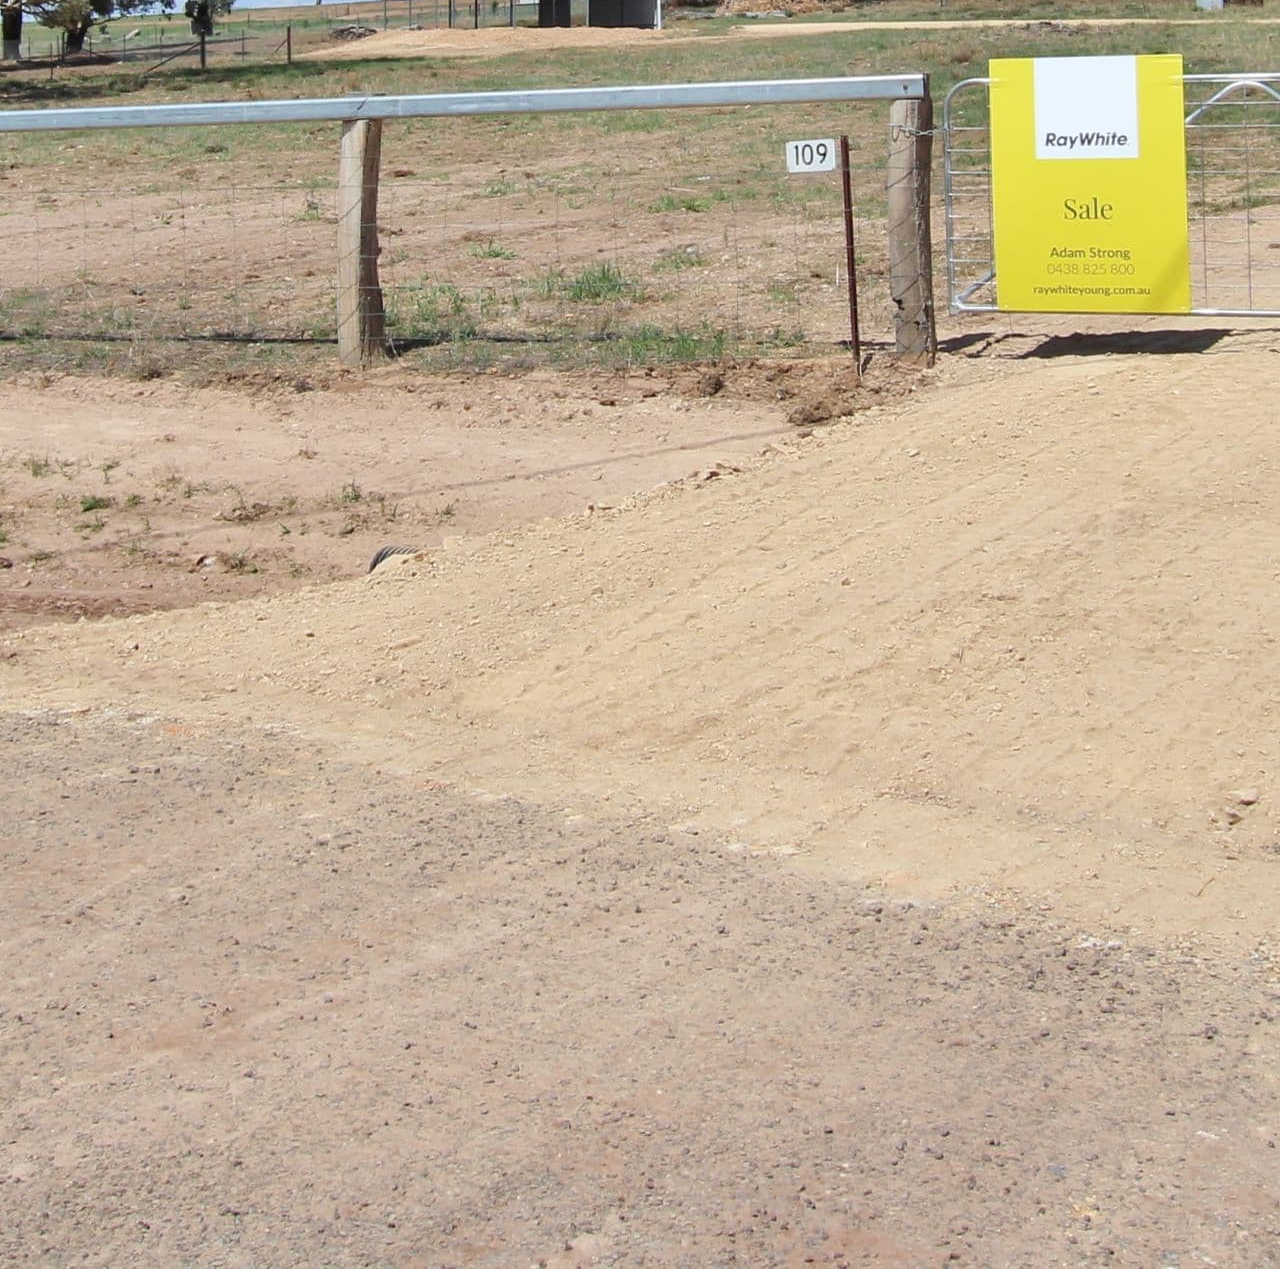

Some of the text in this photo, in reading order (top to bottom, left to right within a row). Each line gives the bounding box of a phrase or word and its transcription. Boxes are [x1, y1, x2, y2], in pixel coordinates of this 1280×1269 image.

[794, 143, 828, 166] 109
[1063, 197, 1114, 221] Sale
[1050, 246, 1131, 261] Adam Strong
[1046, 263, 1136, 276] 0438 825 800
[1033, 284, 1151, 297] raywhiteyoung.com.au
